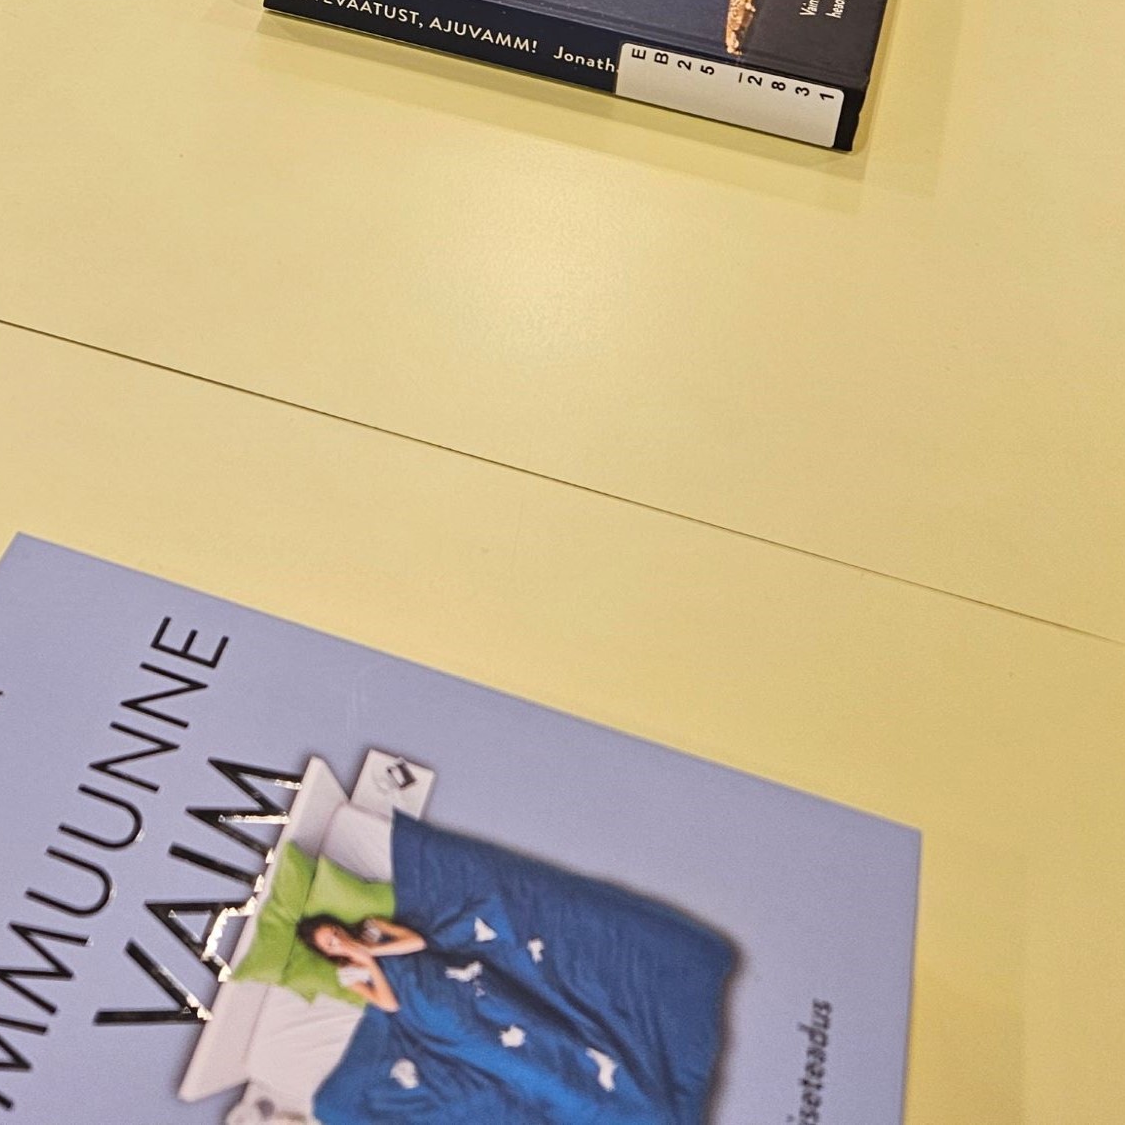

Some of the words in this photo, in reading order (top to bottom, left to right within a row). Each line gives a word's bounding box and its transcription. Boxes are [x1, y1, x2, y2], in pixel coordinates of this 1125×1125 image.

[429, 15, 538, 56] AJUVAMM!
[554, 45, 617, 74] Jonath
[92, 757, 306, 1026] VAIM
